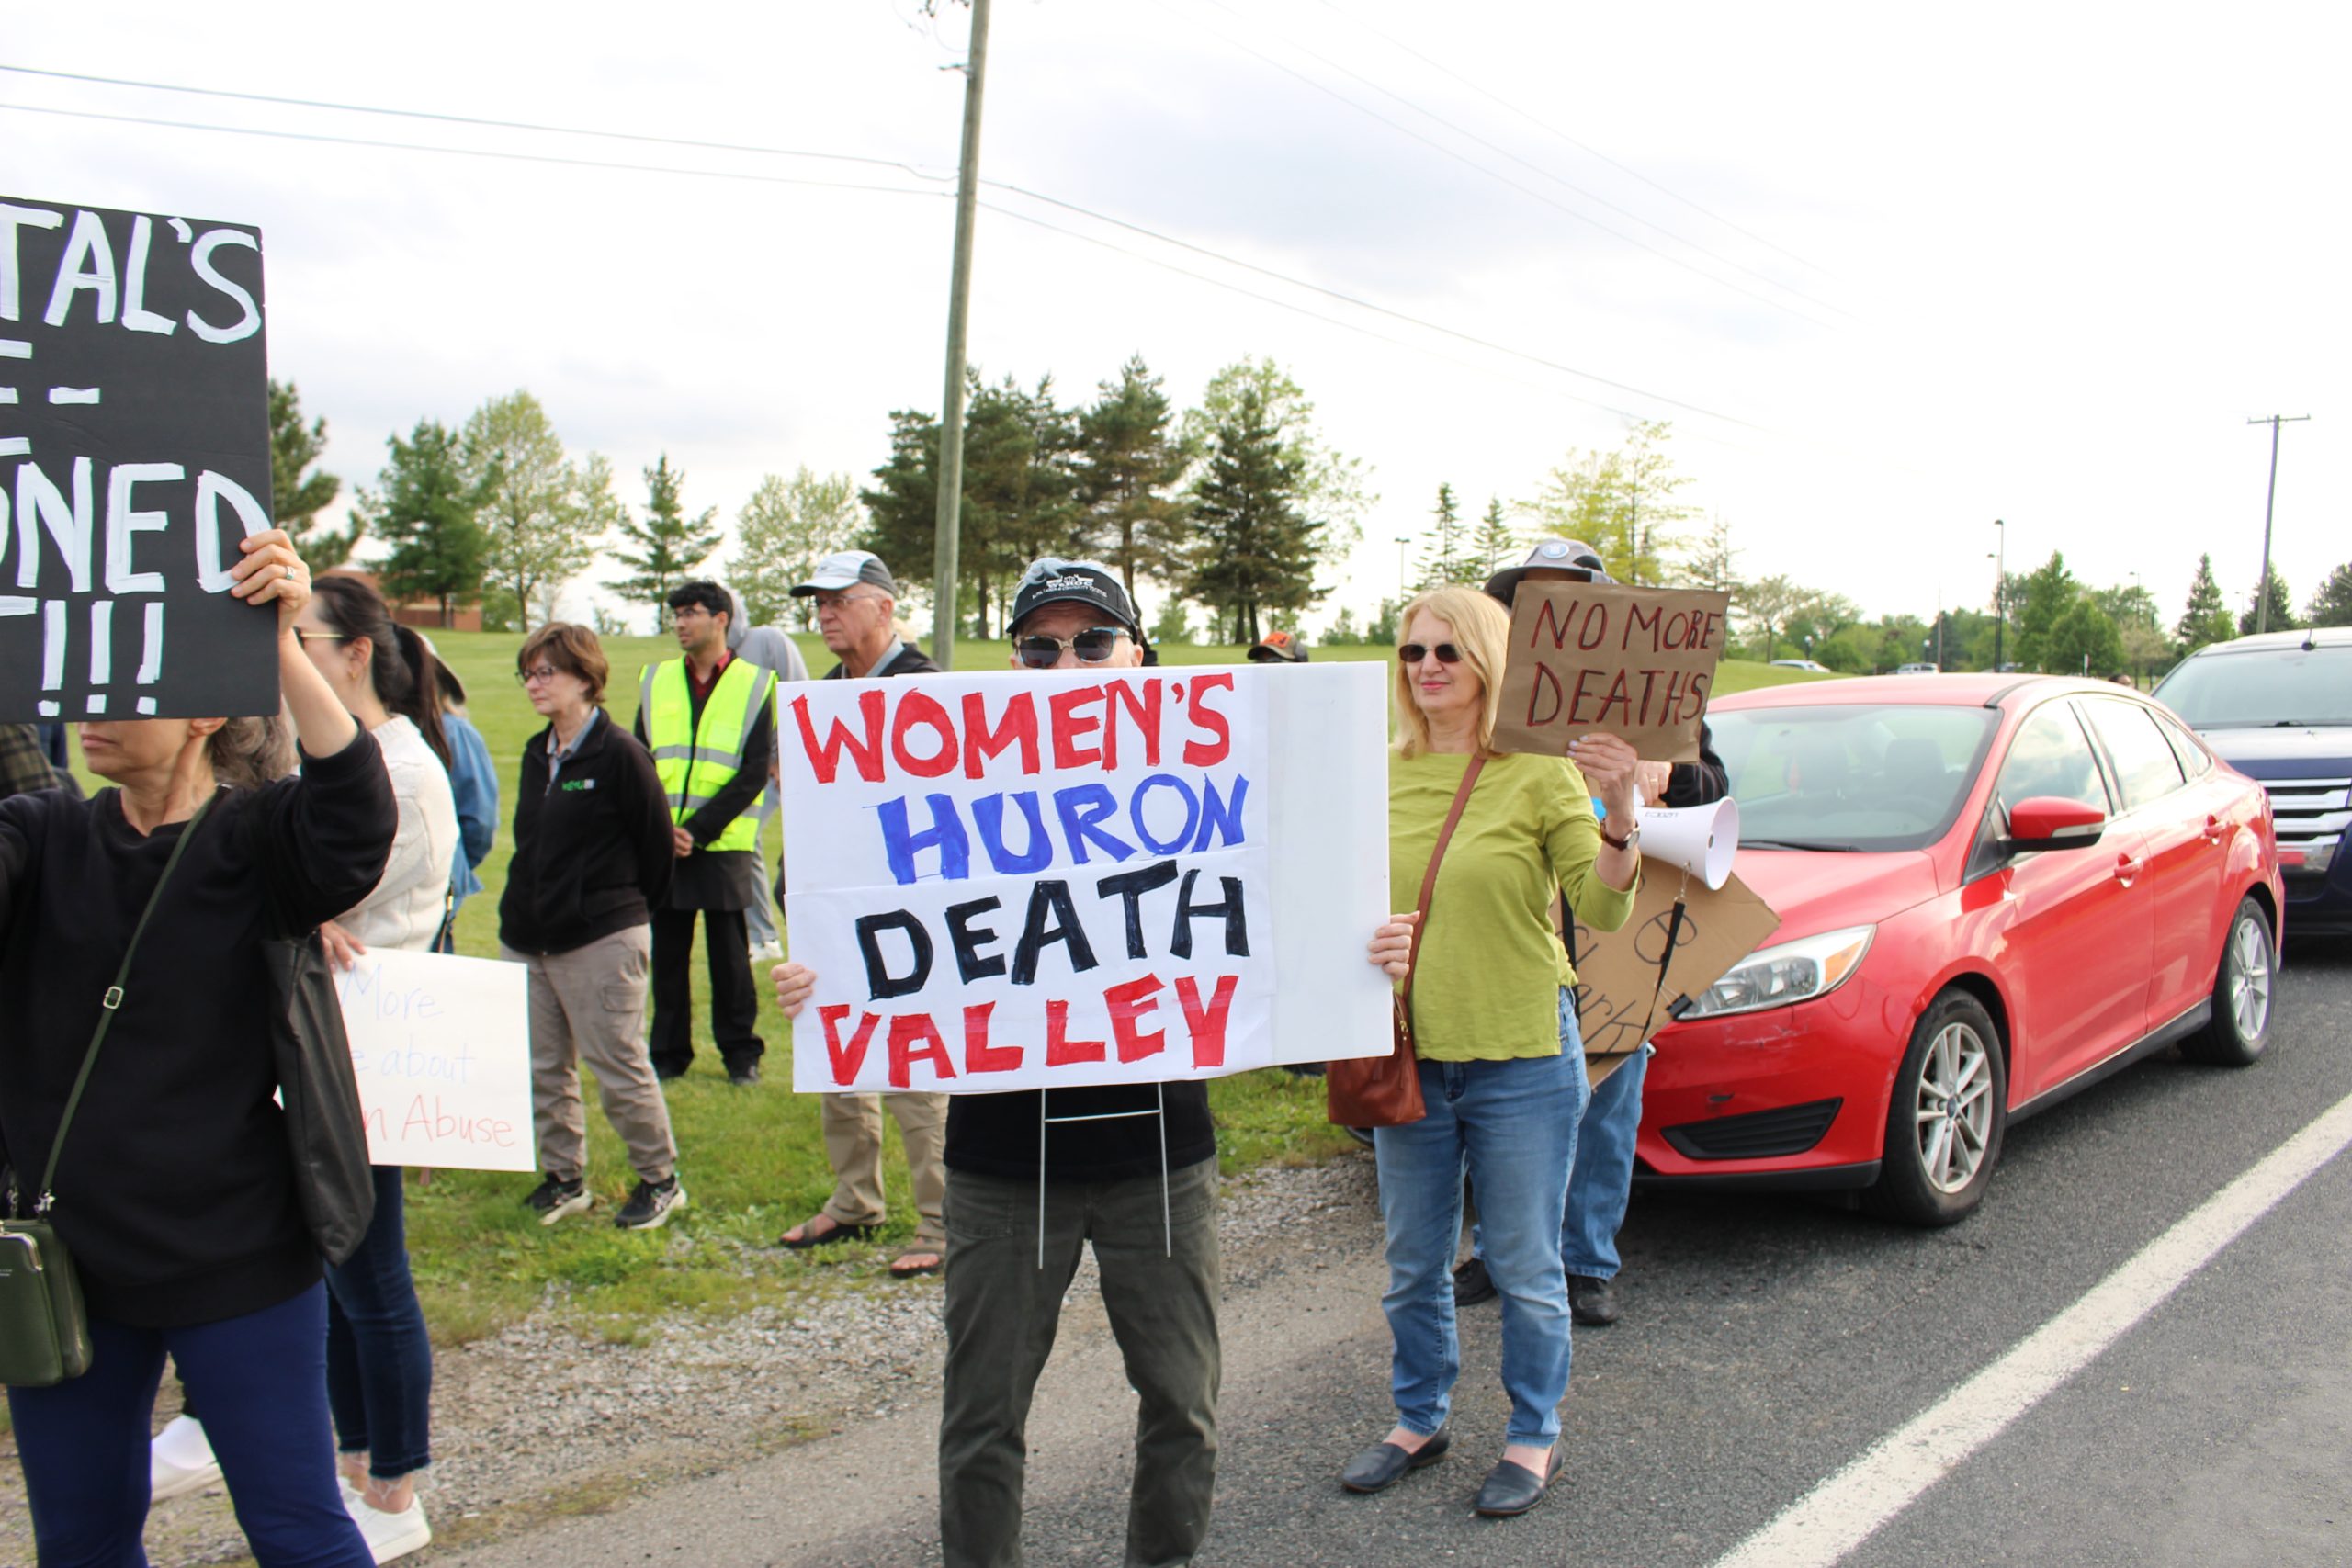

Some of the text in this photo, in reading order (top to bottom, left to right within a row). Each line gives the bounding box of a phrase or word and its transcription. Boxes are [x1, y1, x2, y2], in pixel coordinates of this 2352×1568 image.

[0, 456, 273, 593] NED
[1530, 598, 1723, 653] NO MORE
[788, 671, 1234, 784] WOMEN'S
[1526, 660, 1708, 728] DEATHS
[864, 773, 1250, 885] HURON
[855, 859, 1250, 1000] DEATH
[340, 962, 445, 1021] More
[816, 973, 1238, 1088] VALLEY
[380, 1034, 477, 1085] about
[401, 1093, 516, 1148] Abuse
